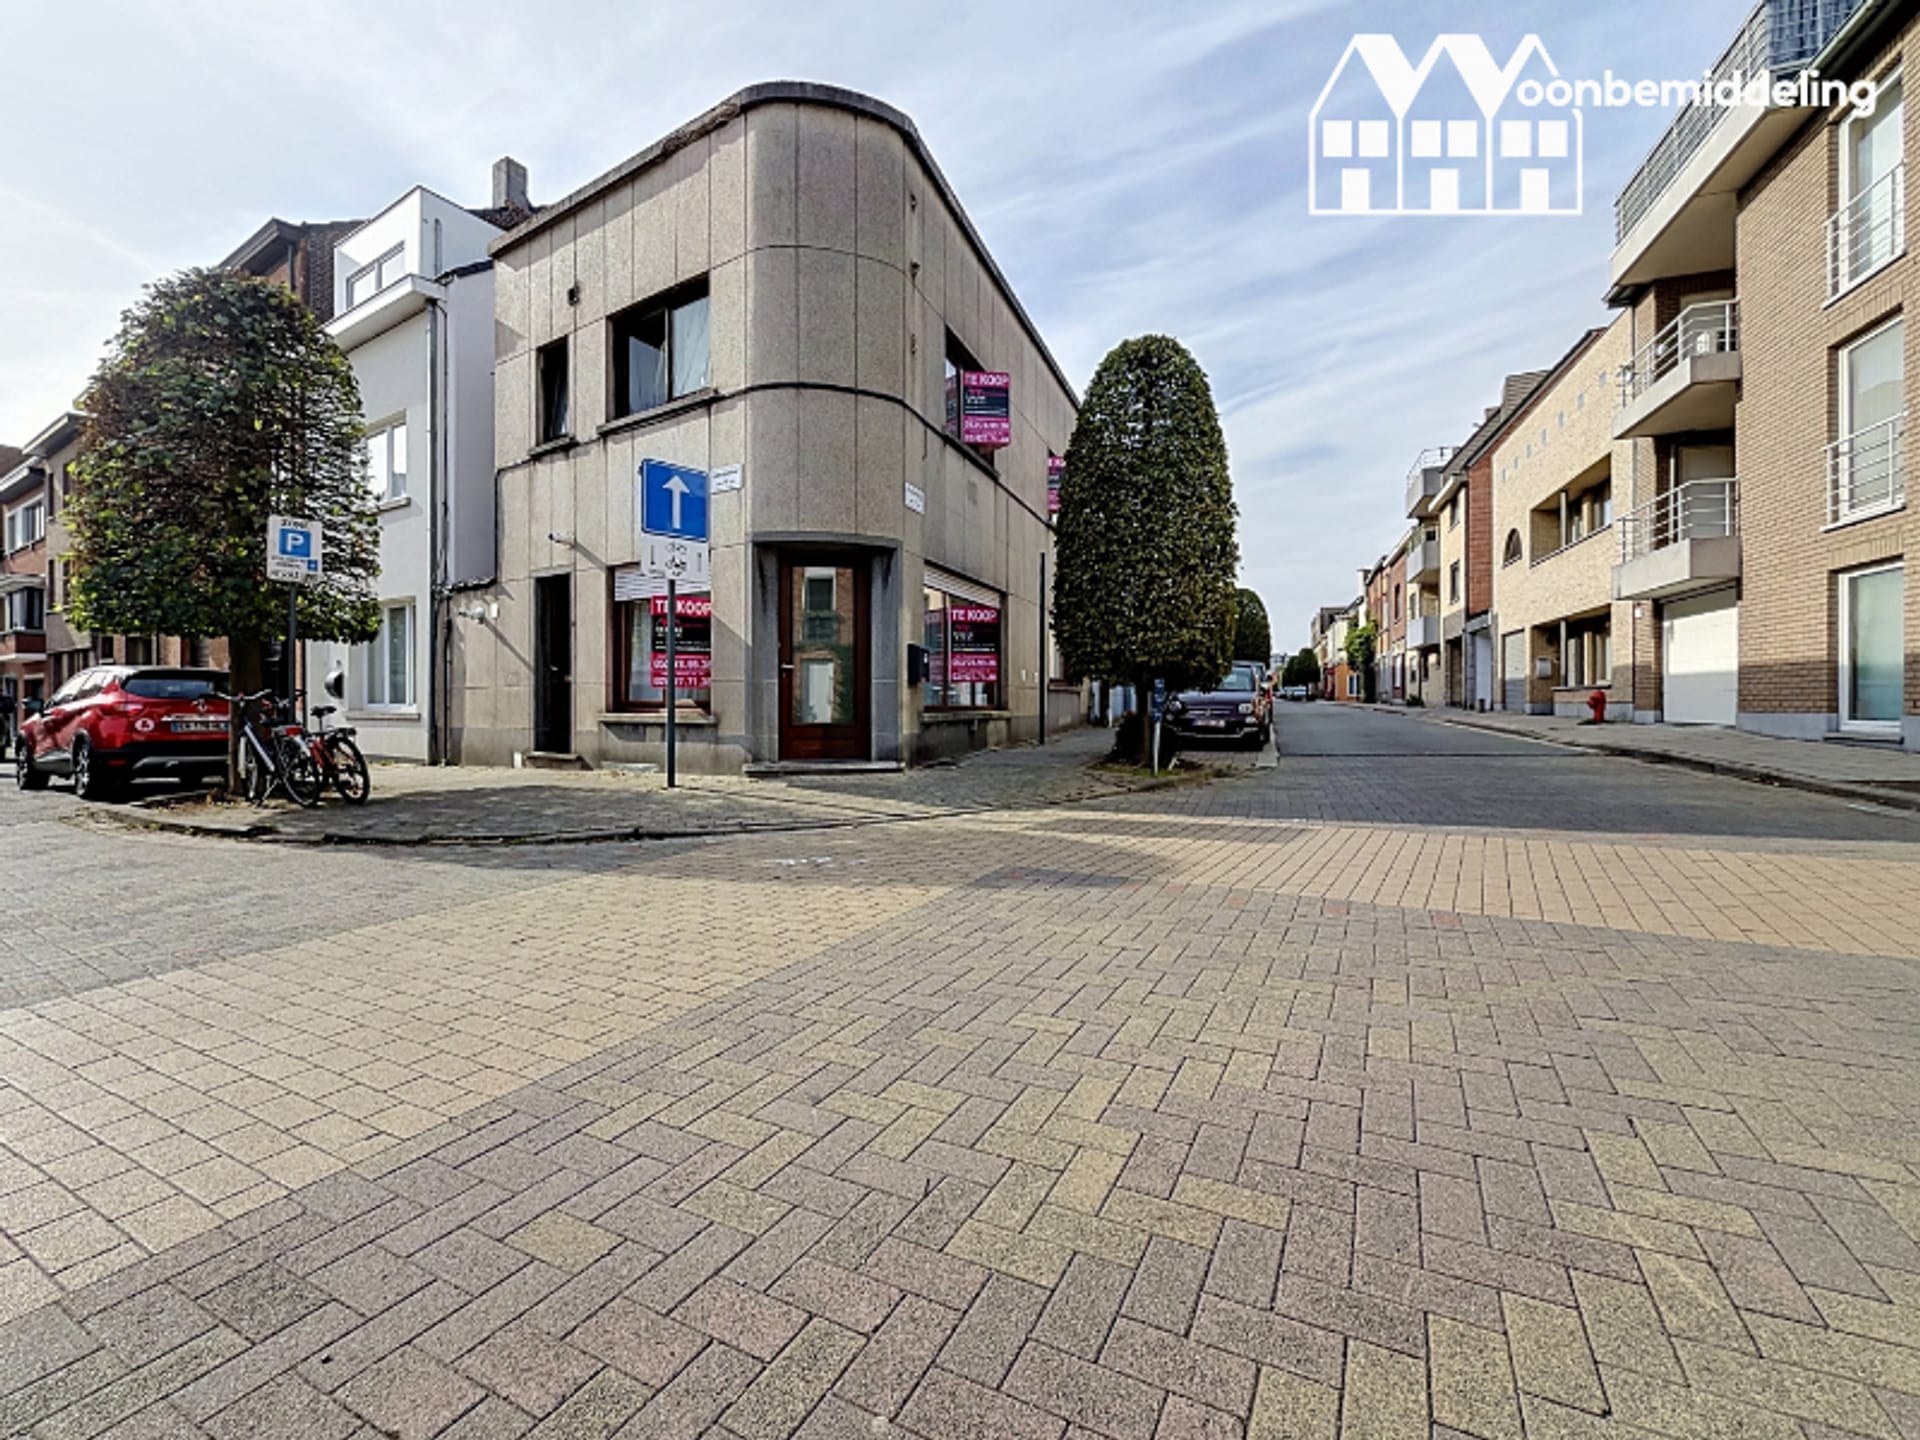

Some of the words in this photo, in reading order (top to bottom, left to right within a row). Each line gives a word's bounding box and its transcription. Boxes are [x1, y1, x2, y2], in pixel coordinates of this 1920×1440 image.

[979, 374, 1009, 387] KOOP
[286, 533, 304, 552] P
[953, 610, 966, 621] TE
[967, 610, 998, 623] KOOP
